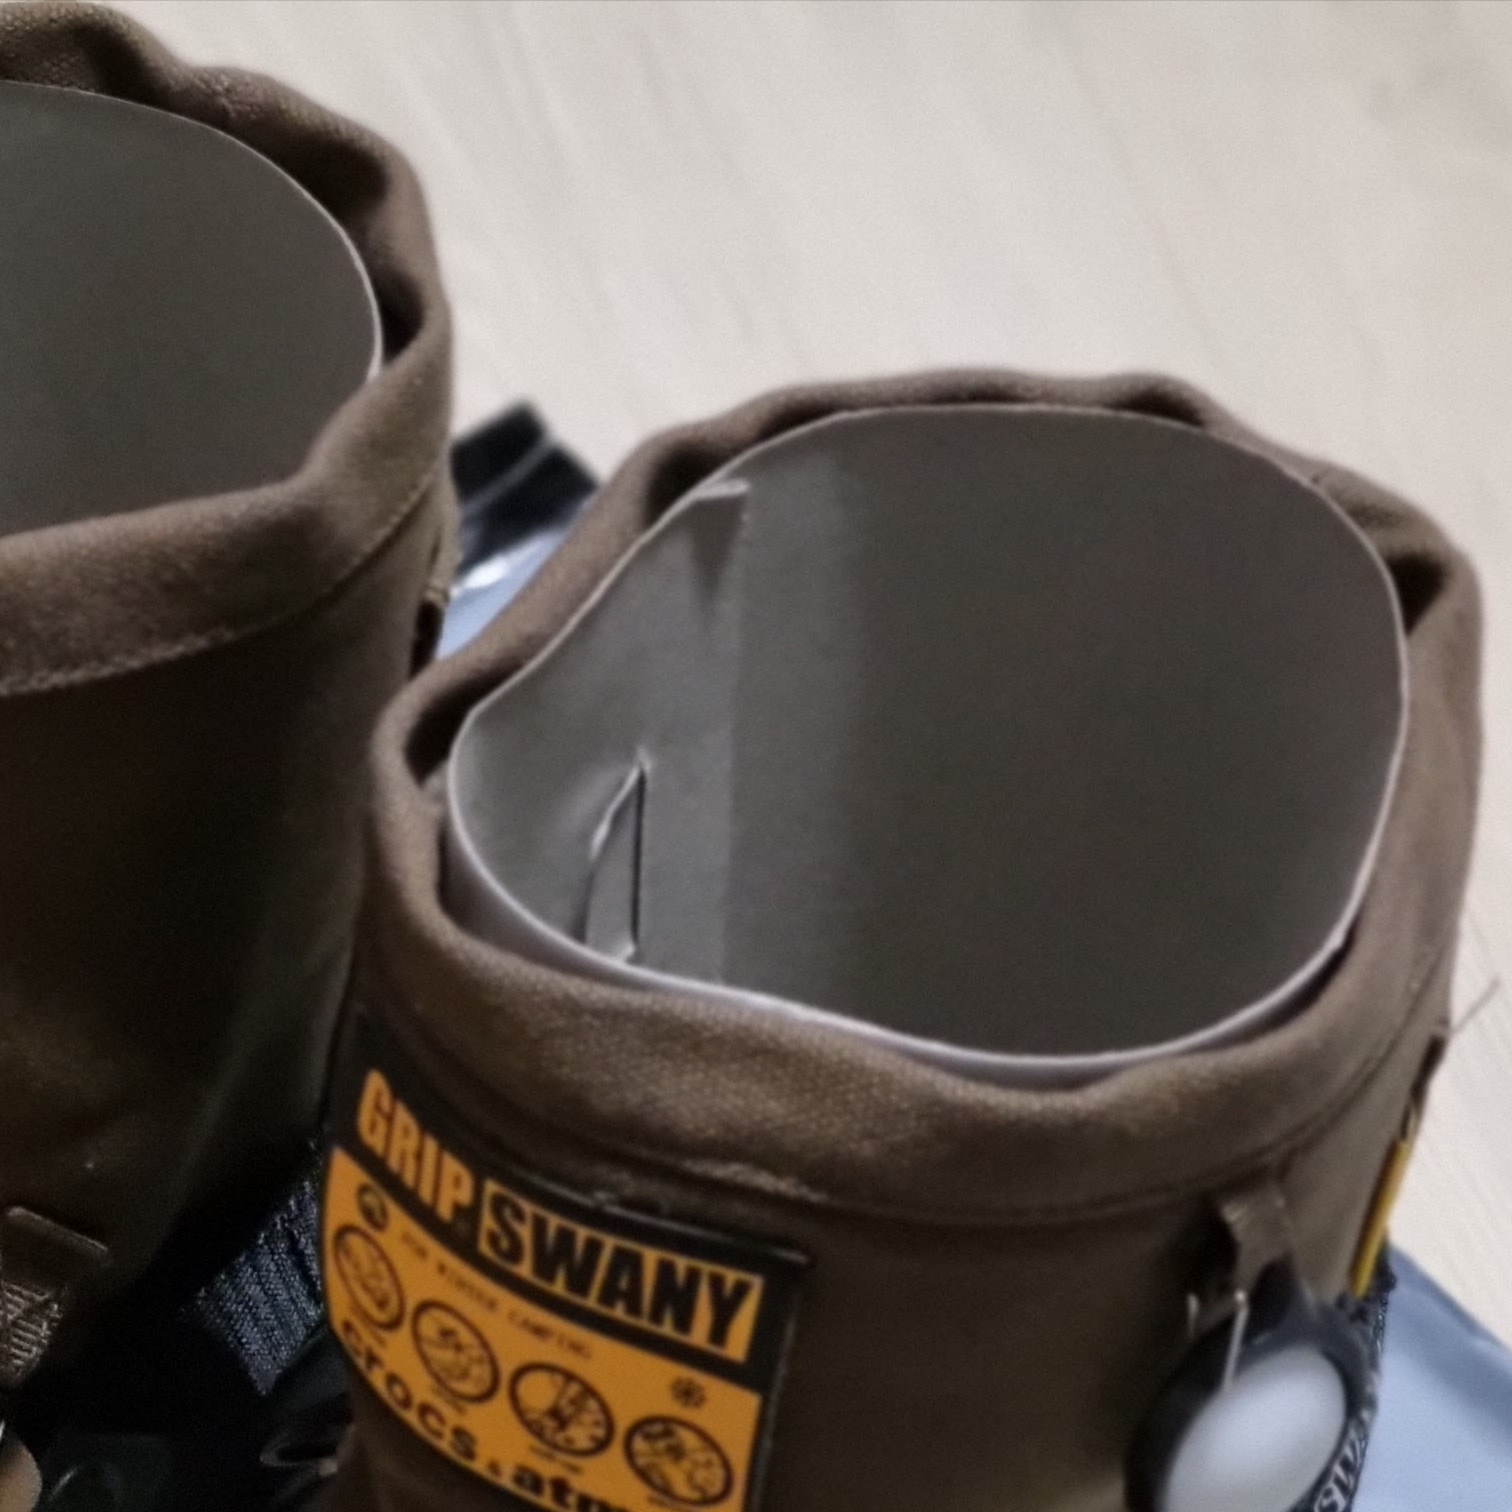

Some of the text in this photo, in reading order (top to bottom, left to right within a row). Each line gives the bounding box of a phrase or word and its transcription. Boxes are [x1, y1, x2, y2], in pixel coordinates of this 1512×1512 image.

[356, 1068, 474, 1223] GRIP
[487, 1192, 752, 1349] SWANY
[342, 1319, 478, 1462] crocs
